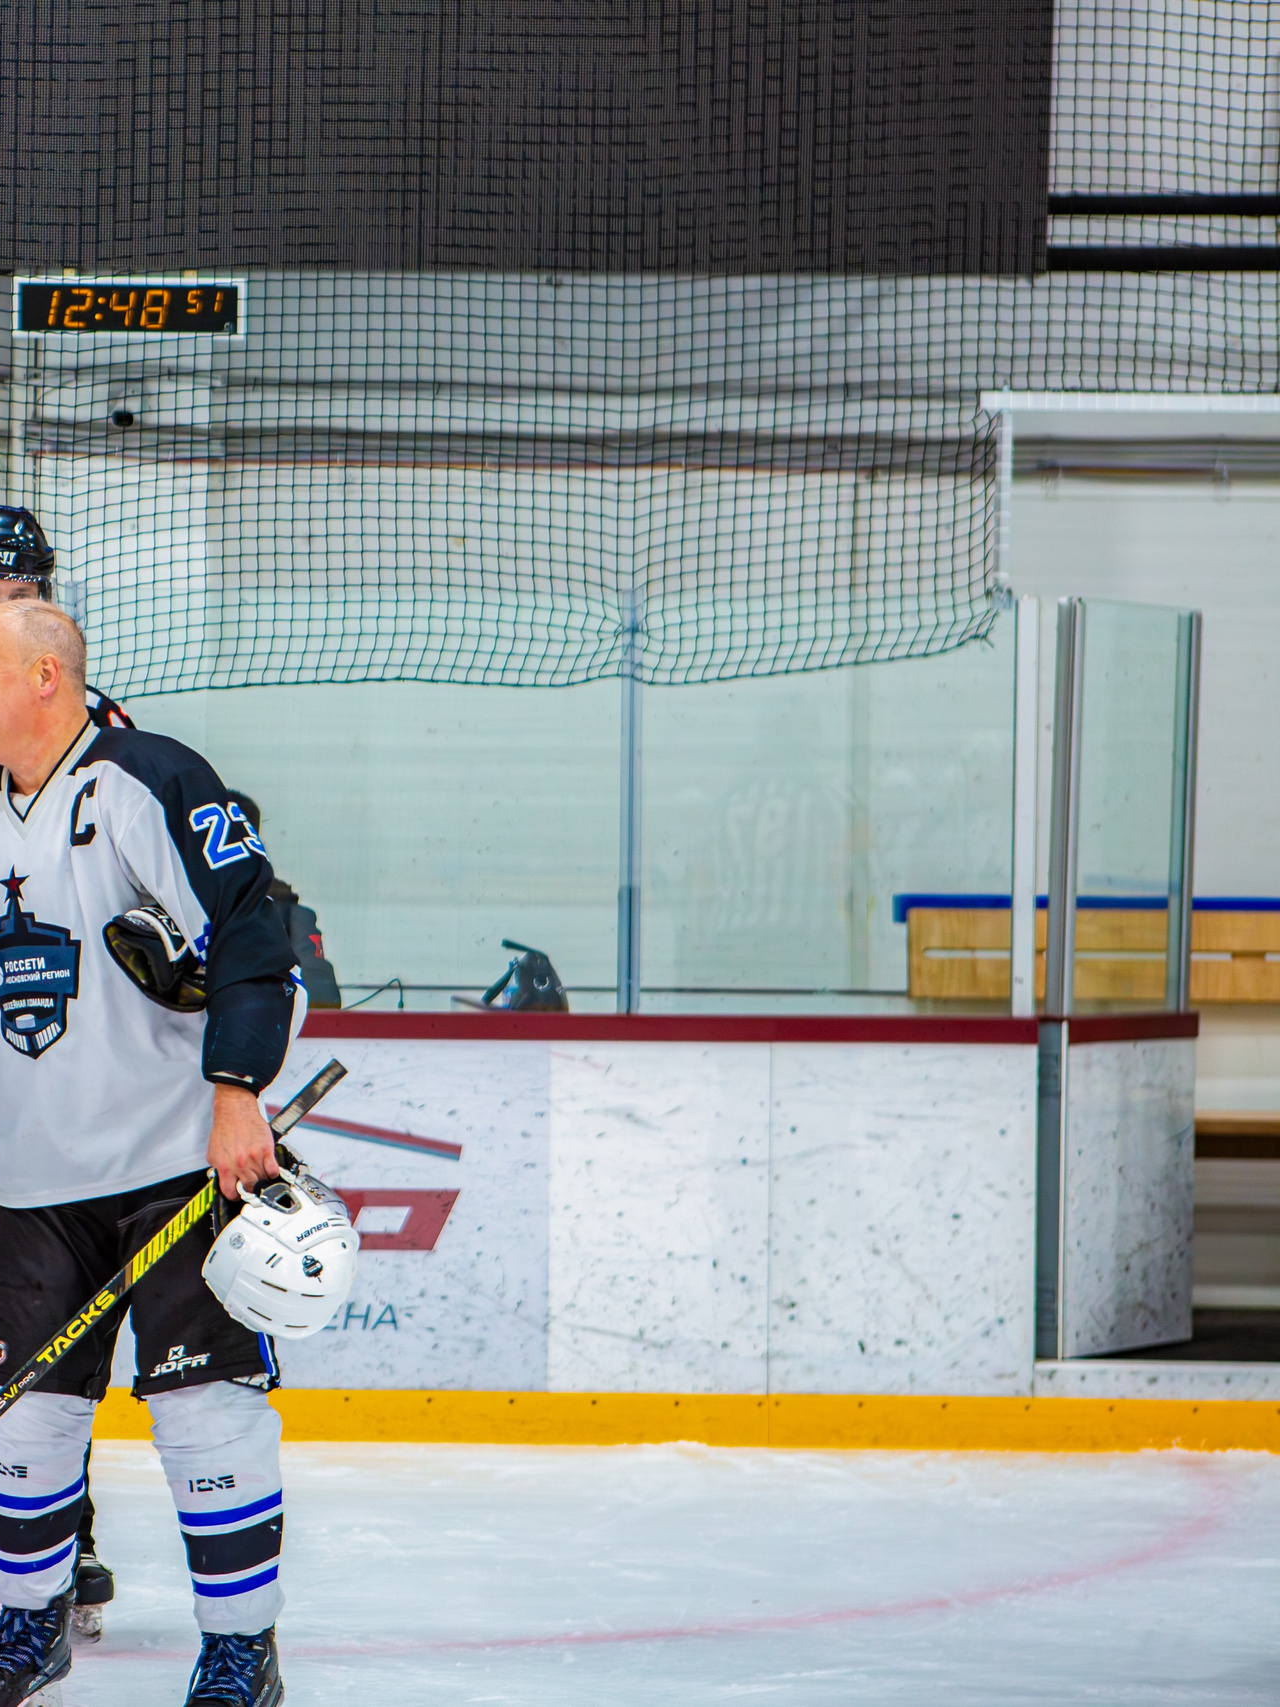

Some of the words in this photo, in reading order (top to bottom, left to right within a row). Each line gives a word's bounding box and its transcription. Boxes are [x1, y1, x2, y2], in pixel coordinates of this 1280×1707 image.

[47, 288, 172, 329] 12:48
[186, 290, 224, 314] 51
[188, 801, 270, 870] 23
[4, 956, 46, 973] РОССЕТИ
[41, 969, 70, 980] РЕГИОН
[296, 1221, 330, 1242] BAUER
[36, 1289, 116, 1364] TACKS
[150, 1353, 211, 1378] JOFA
[18, 1371, 36, 1389] PRO
